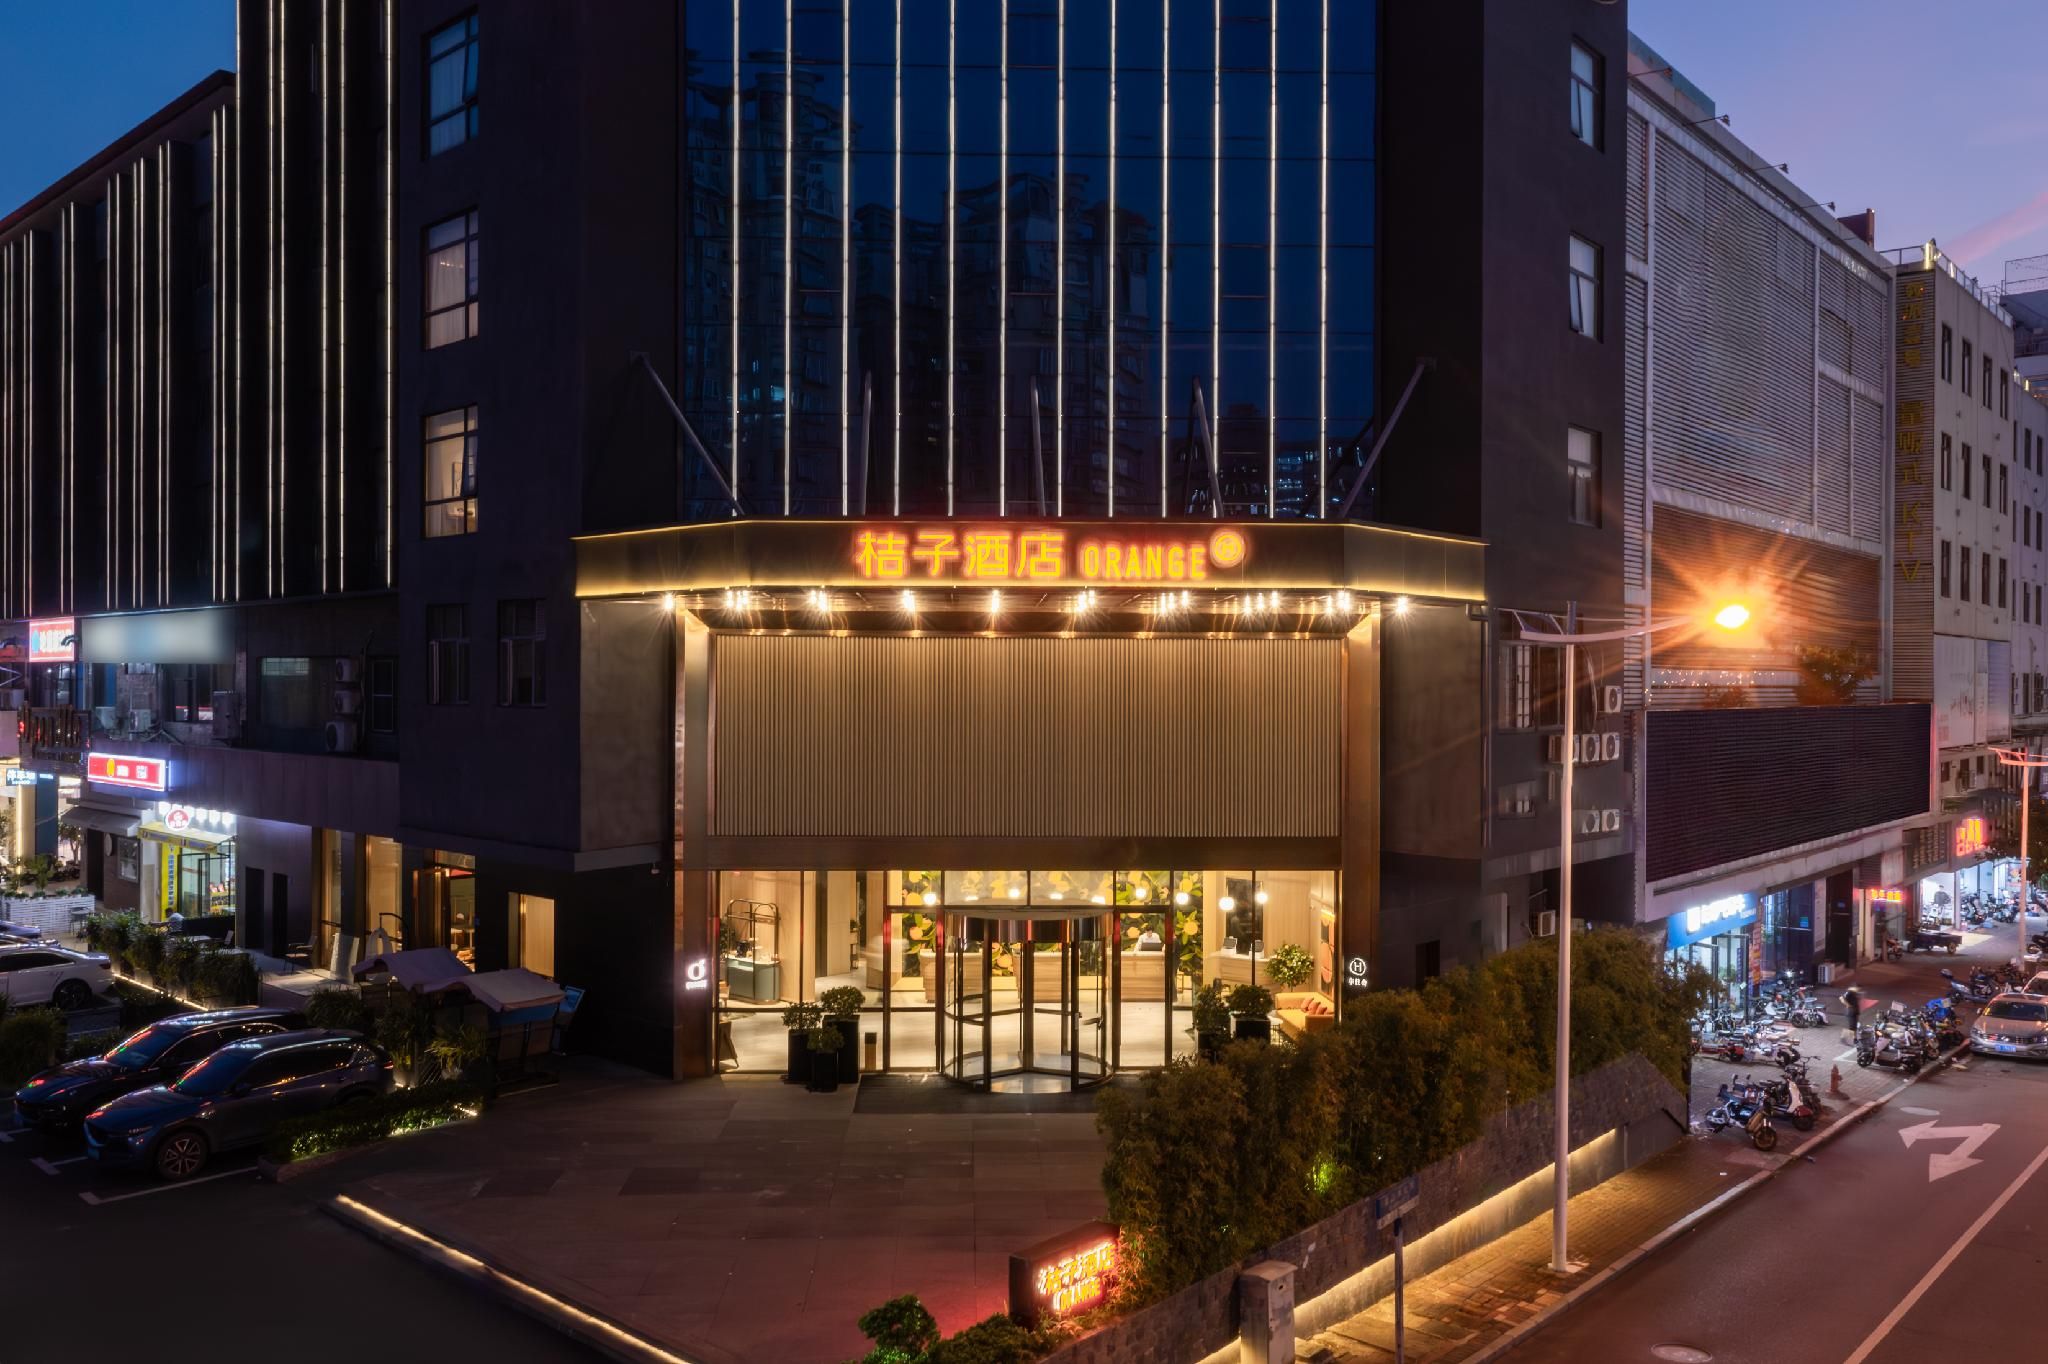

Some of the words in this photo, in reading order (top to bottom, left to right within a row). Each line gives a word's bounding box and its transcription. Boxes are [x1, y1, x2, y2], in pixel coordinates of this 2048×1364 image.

[857, 531, 1066, 578] 桔子酒店
[1083, 545, 1207, 578] ORANGE
[1039, 1241, 1117, 1297] 桔子酒店
